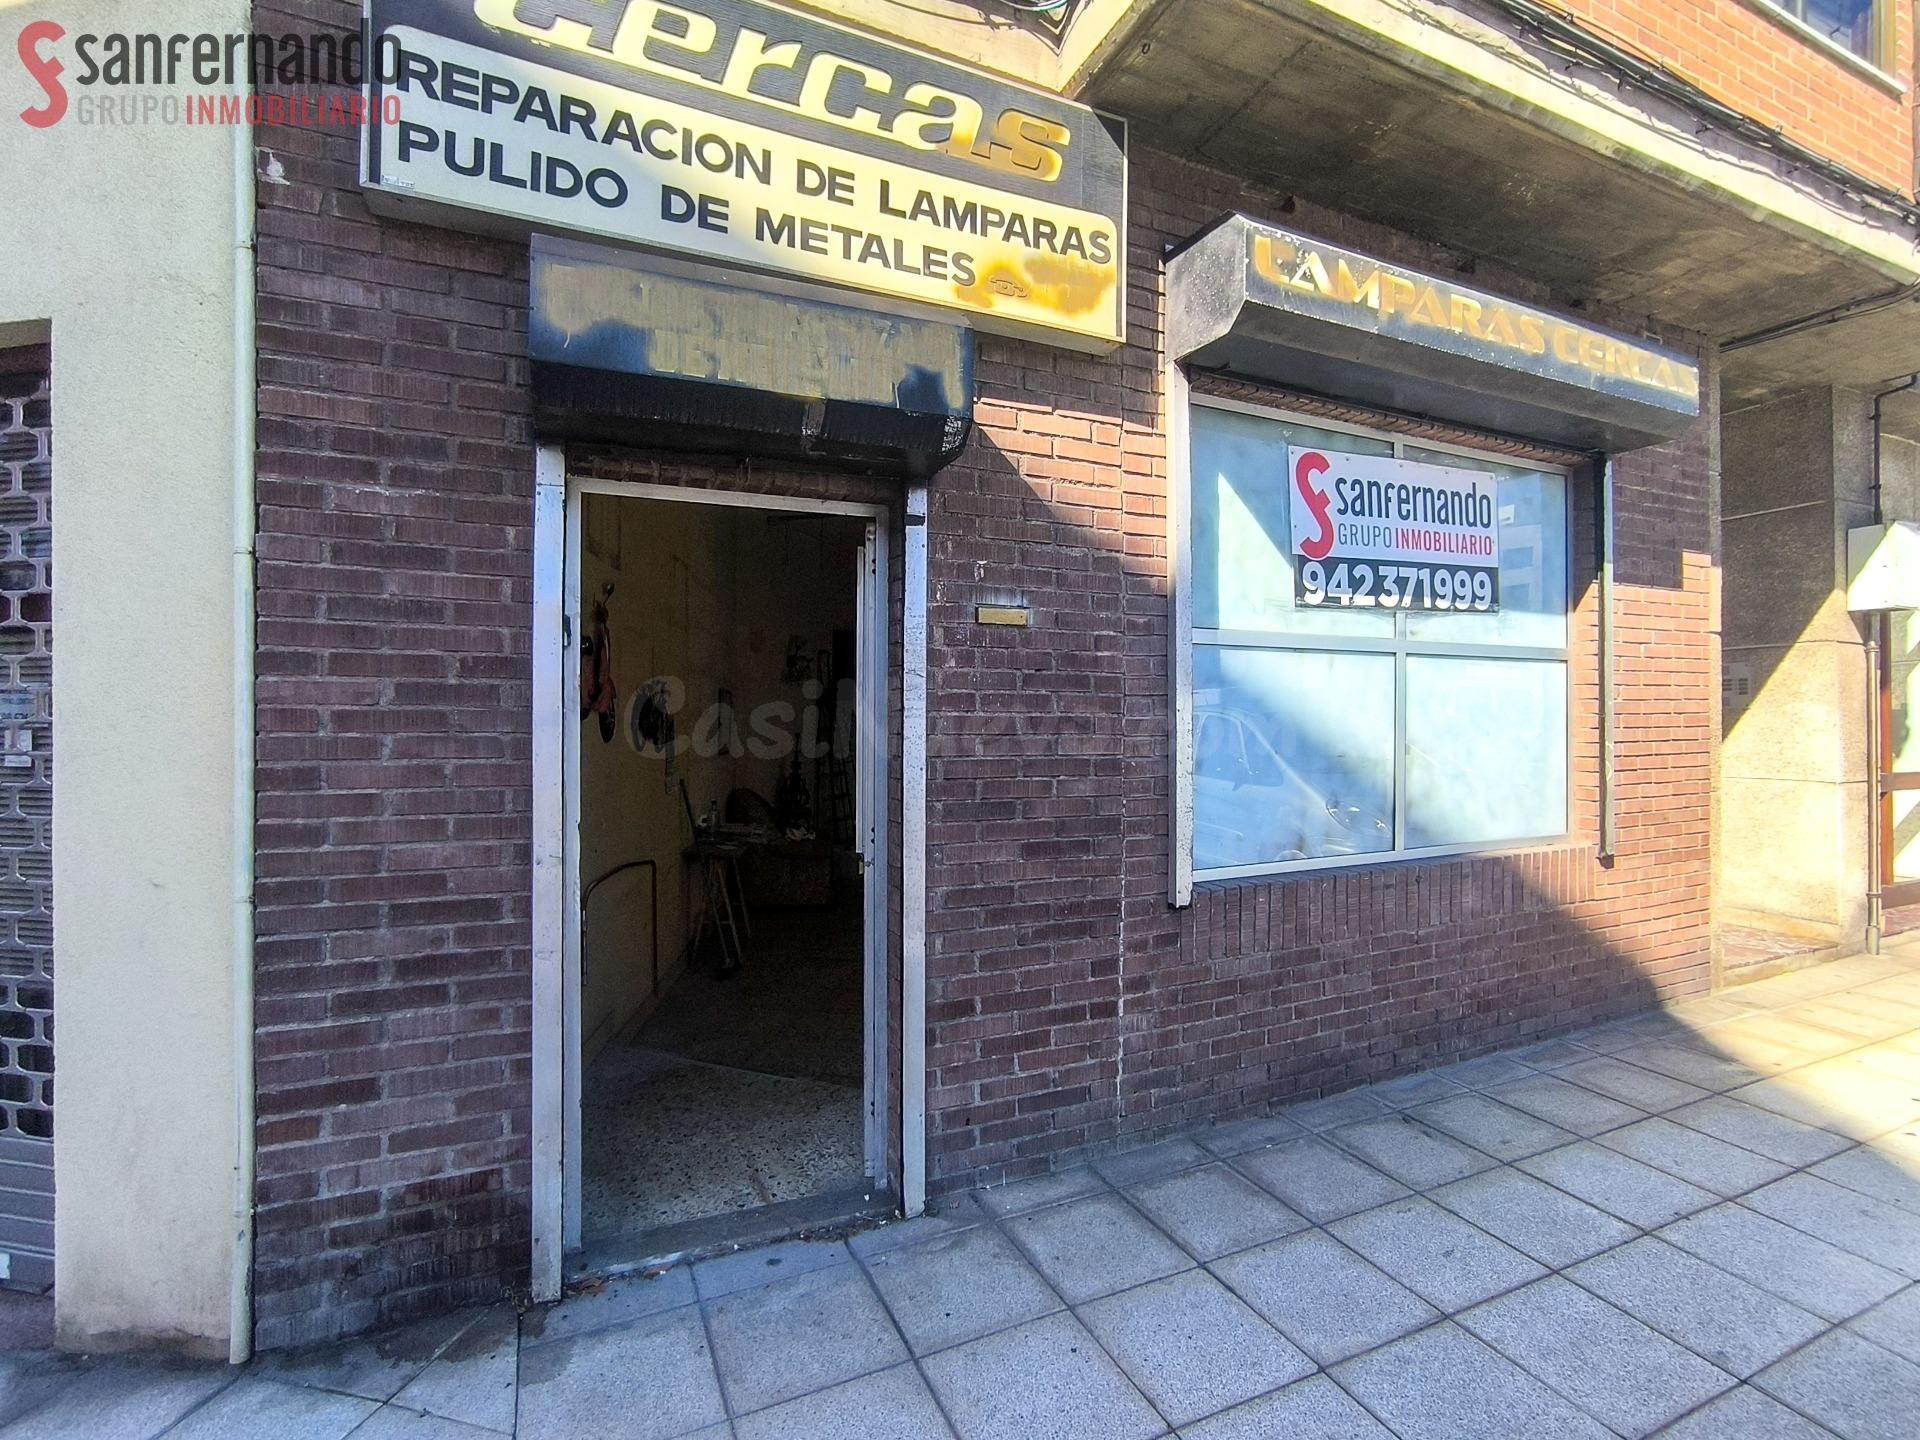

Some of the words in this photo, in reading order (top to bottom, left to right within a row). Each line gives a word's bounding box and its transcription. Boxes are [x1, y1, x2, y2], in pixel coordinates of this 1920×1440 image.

[396, 48, 772, 186] REPARACION
[796, 159, 855, 206] DE
[880, 179, 1112, 265] LAMPARAS
[398, 120, 628, 208] PULIDO
[661, 184, 729, 234] DE
[755, 207, 976, 287] METALES
[1335, 477, 1492, 529] sanfernando
[1338, 523, 1392, 548] GRUPO
[1395, 527, 1493, 556] INMOBILIARIO
